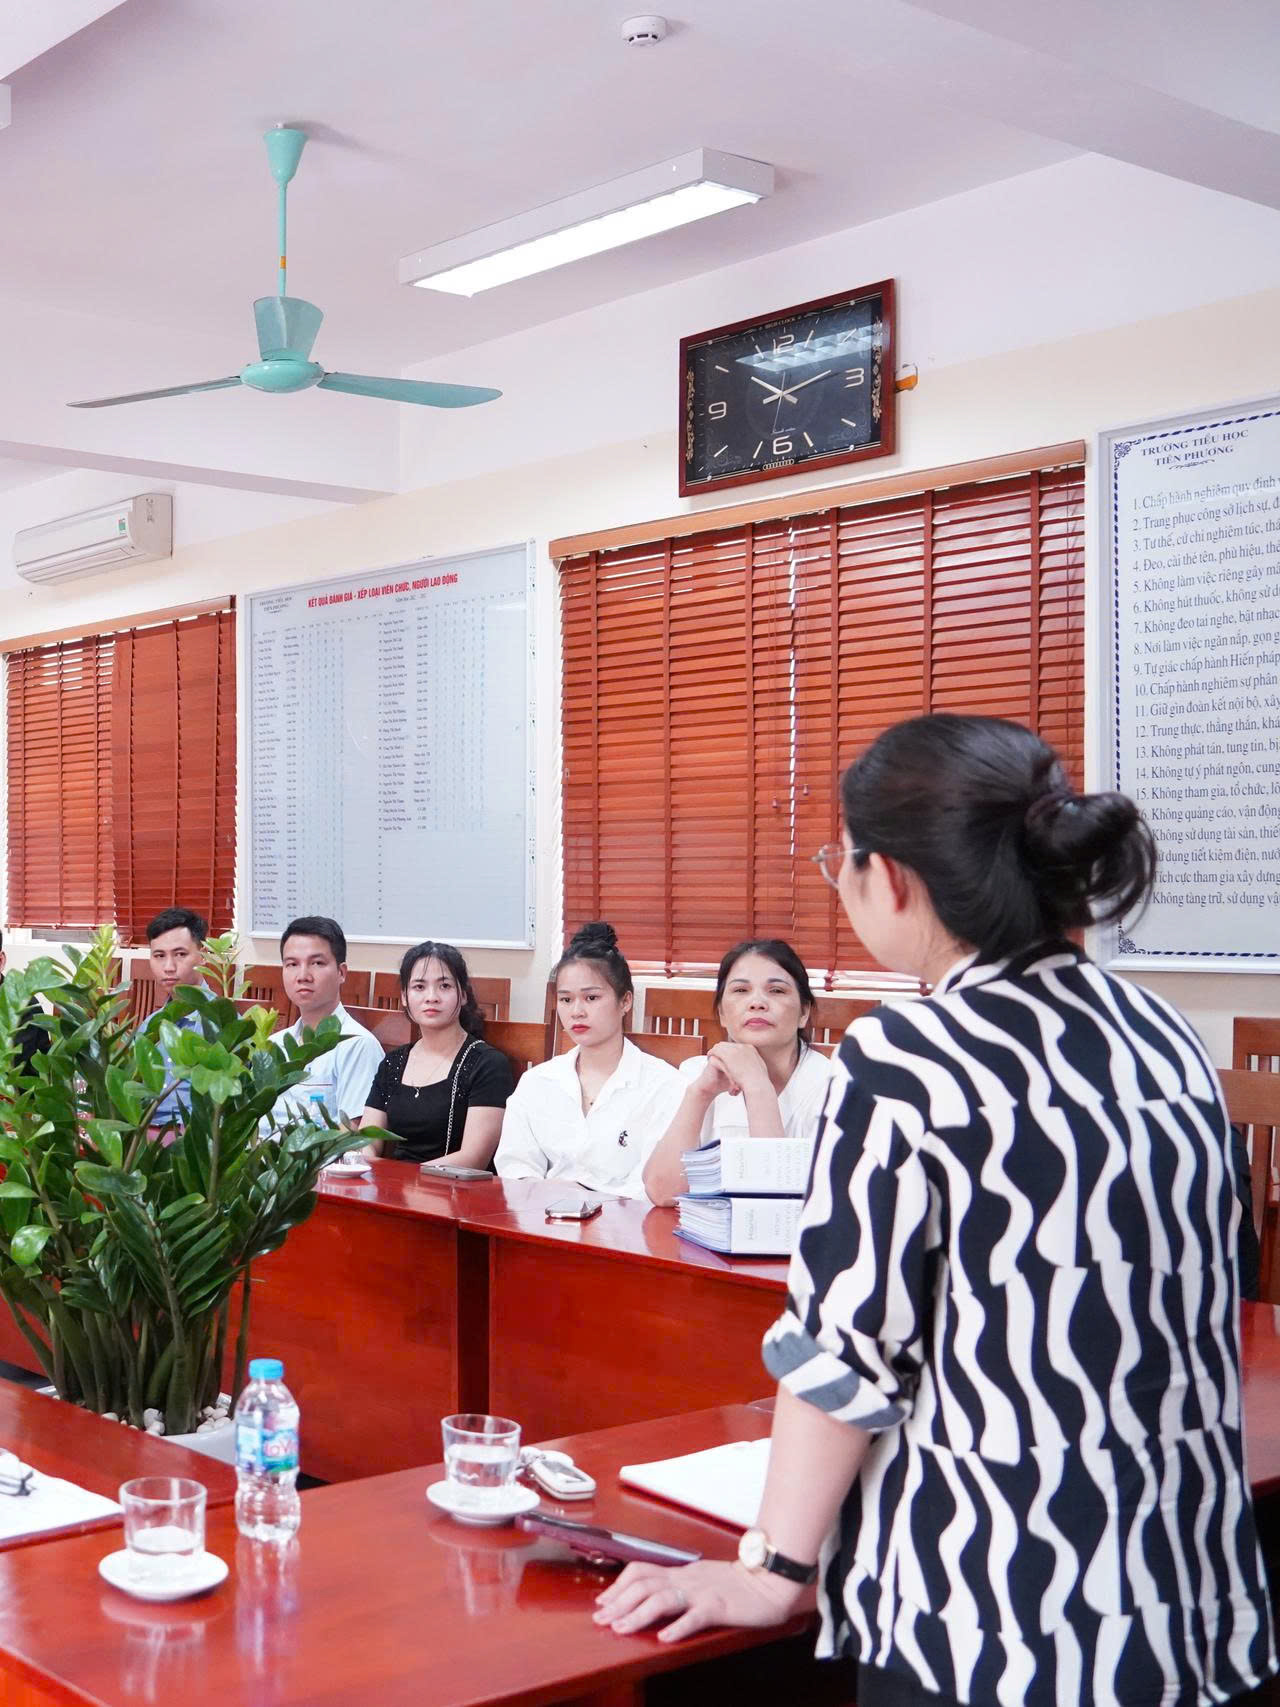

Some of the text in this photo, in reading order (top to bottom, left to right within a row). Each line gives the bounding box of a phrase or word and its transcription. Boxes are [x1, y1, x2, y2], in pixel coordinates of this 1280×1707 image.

[773, 334, 794, 354] 12
[844, 368, 864, 388] 3
[708, 401, 727, 420] 9
[773, 435, 792, 455] 6
[1142, 430, 1249, 456] TRƯỜNG TIỂU HỌC
[1184, 445, 1233, 461] PHƯƠNG
[1253, 476, 1276, 489] định
[1143, 508, 1221, 529] Trang phục công
[1143, 526, 1243, 550] Tư nghiêm
[1143, 545, 1264, 571] Đeo, cài tên, phù hiệu,
[1144, 565, 1263, 592] Không làm việc riêng gây
[308, 597, 317, 608] KẾT
[319, 596, 328, 607] QUẢ
[329, 594, 343, 605] ĐÁNH
[344, 591, 353, 603] GIÁ
[357, 589, 367, 600] XẾP
[368, 588, 381, 601] LOẠI
[382, 586, 394, 596] VIÊN
[412, 578, 429, 590] NGƯỜI
[430, 577, 440, 587] LAO
[442, 572, 458, 586] ĐỘNG
[1144, 600, 1175, 613] Không
[1194, 590, 1224, 607] thuốc,
[1226, 589, 1256, 602] không
[1144, 612, 1237, 634] Không đeo tai nghe,
[1144, 642, 1161, 653] Nơi
[1163, 640, 1181, 651] làm
[1182, 637, 1202, 650] việc
[1253, 632, 1272, 646] gọn
[1159, 650, 1255, 677] giác chấp hành Hiến
[1136, 673, 1278, 696] 10. Chấp hành nghiêm phân
[1136, 701, 1210, 717] 11. đoàn
[1136, 724, 1179, 738] 12. Trung
[1136, 743, 1249, 759] 13. Không phát tung
[1136, 762, 1254, 780] 14. Không phát ngôn,
[1136, 786, 1229, 801] 15. Không tham gia,
[1152, 805, 1256, 822] Không vận
[1152, 829, 1221, 843] Không dụng
[1166, 847, 1259, 864] dụng tiết kiệm điện,
[1175, 870, 1253, 885] cực tham gia xây
[1153, 891, 1265, 907] Không tàng dụng
